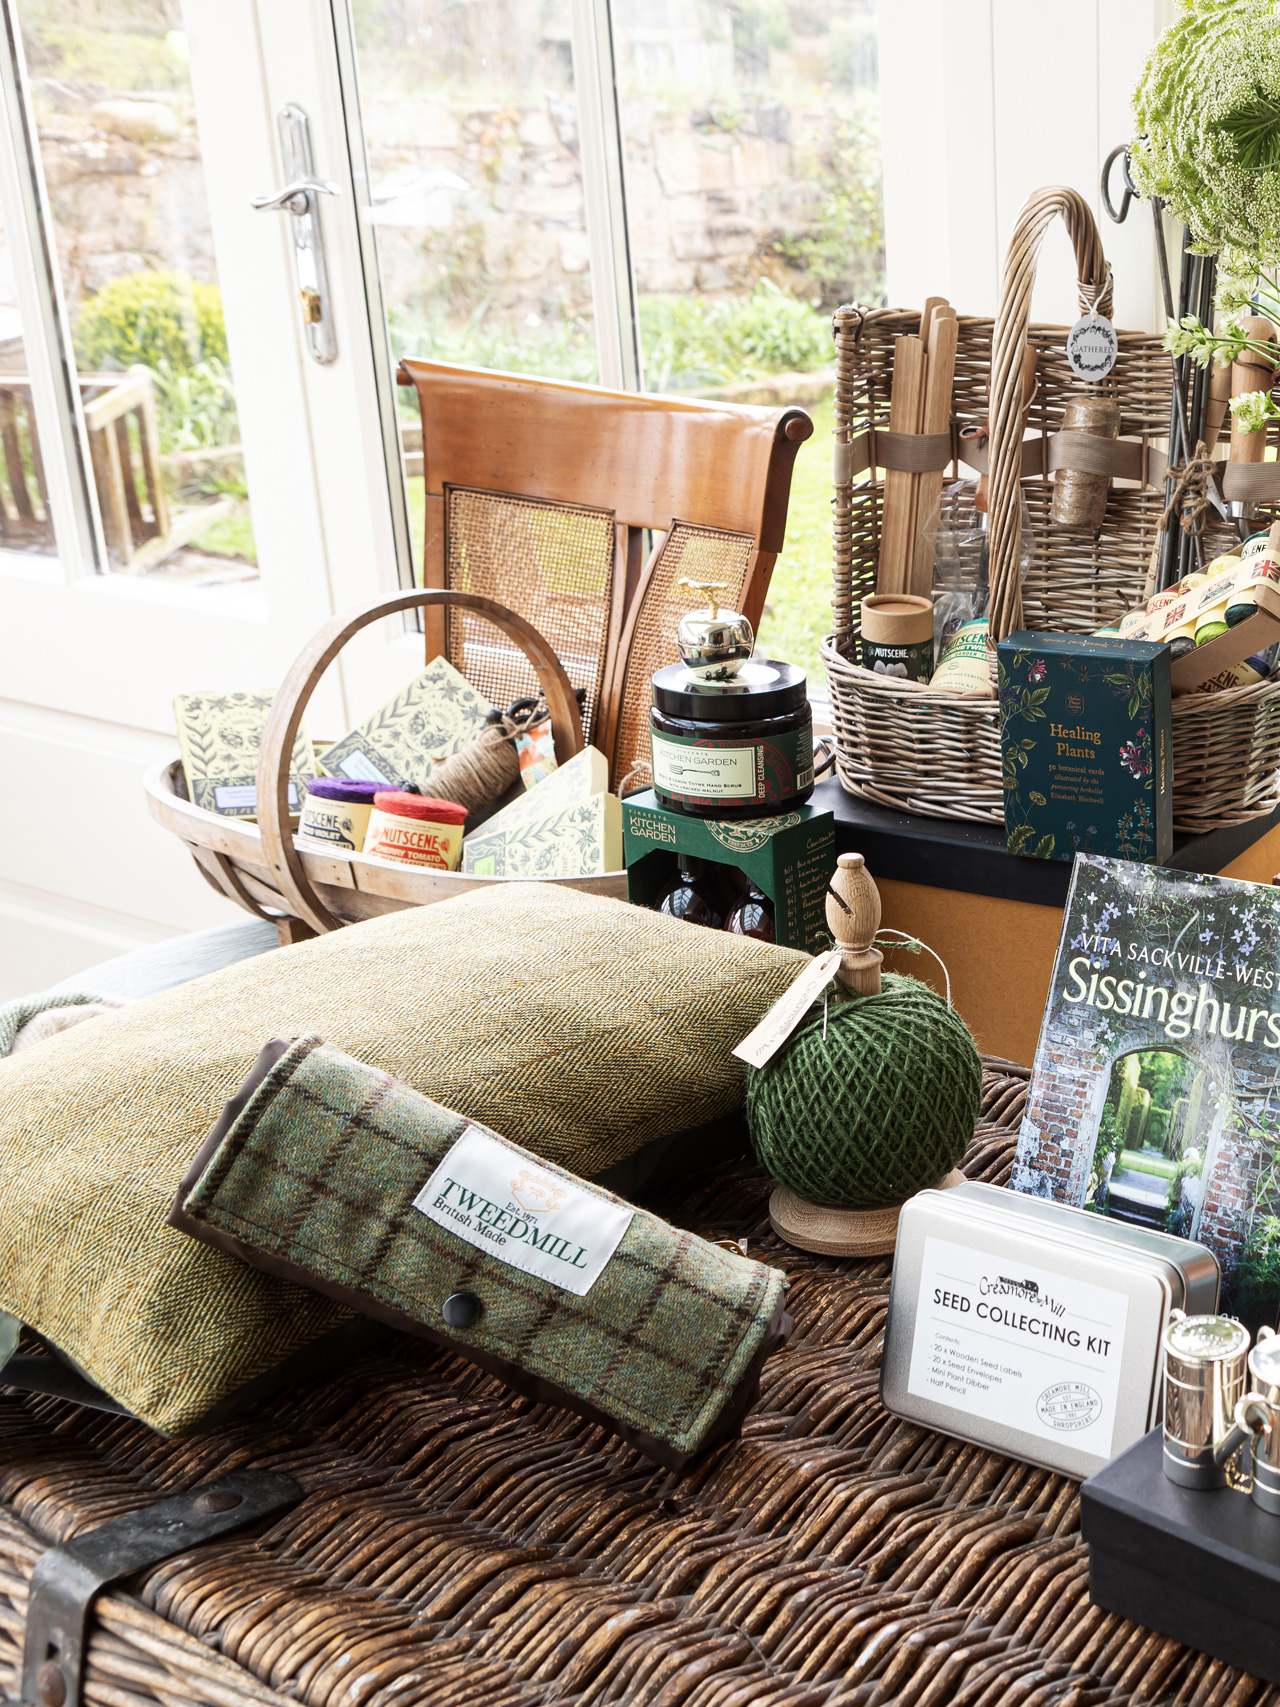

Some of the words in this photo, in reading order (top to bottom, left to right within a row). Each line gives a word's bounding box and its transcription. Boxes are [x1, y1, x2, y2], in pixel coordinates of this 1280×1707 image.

[874, 648, 909, 658] NUTSCENE
[1050, 723, 1101, 745] Healing
[660, 749, 692, 763] KITCHEN
[694, 757, 737, 765] GARDEN
[1057, 742, 1095, 759] Plants
[1058, 764, 1086, 773] botanical
[1054, 774, 1082, 782] illustrated
[1083, 777, 1089, 785] by
[1051, 784, 1079, 793] pioneering
[1080, 786, 1103, 794] herbalist
[1051, 792, 1076, 800] Elizabeth
[1078, 796, 1104, 804] Blackwell
[629, 816, 676, 834] KITCHEN
[383, 827, 440, 849] NUTSCENE
[630, 826, 676, 844] GARDEN
[376, 845, 406, 858] CHERRY
[407, 850, 441, 862] TOMATO
[1081, 931, 1122, 957] VITA
[432, 1196, 472, 1227] British
[473, 1222, 507, 1246] Made
[505, 1202, 521, 1216] Est.
[522, 1212, 538, 1224] 1971
[440, 1177, 588, 1269] TWEEDMILL
[979, 1276, 1038, 1303] Creamore
[1040, 1295, 1066, 1318] Mill
[934, 1288, 970, 1312] SEED
[976, 1302, 1081, 1347] COLLECTING
[1087, 1336, 1111, 1356] KIT
[935, 1332, 960, 1345] Contents:
[933, 1355, 940, 1363] 20
[947, 1360, 965, 1372] Seed
[967, 1366, 1002, 1384] Envelopes
[934, 1344, 942, 1352] 20
[950, 1349, 979, 1362] Wooden
[980, 1357, 999, 1370] Seed
[1000, 1365, 1023, 1378] Labels
[930, 1378, 944, 1388] Half
[945, 1382, 966, 1394] Pencil
[932, 1367, 945, 1376] Mini
[947, 1372, 964, 1383] Plant
[966, 1378, 990, 1391] Dibber
[1042, 1384, 1070, 1401] CREAMORE
[1075, 1385, 1090, 1395] MILL
[1071, 1399, 1098, 1409] ENGLAND
[1053, 1415, 1093, 1428] SHROPSHIRE
